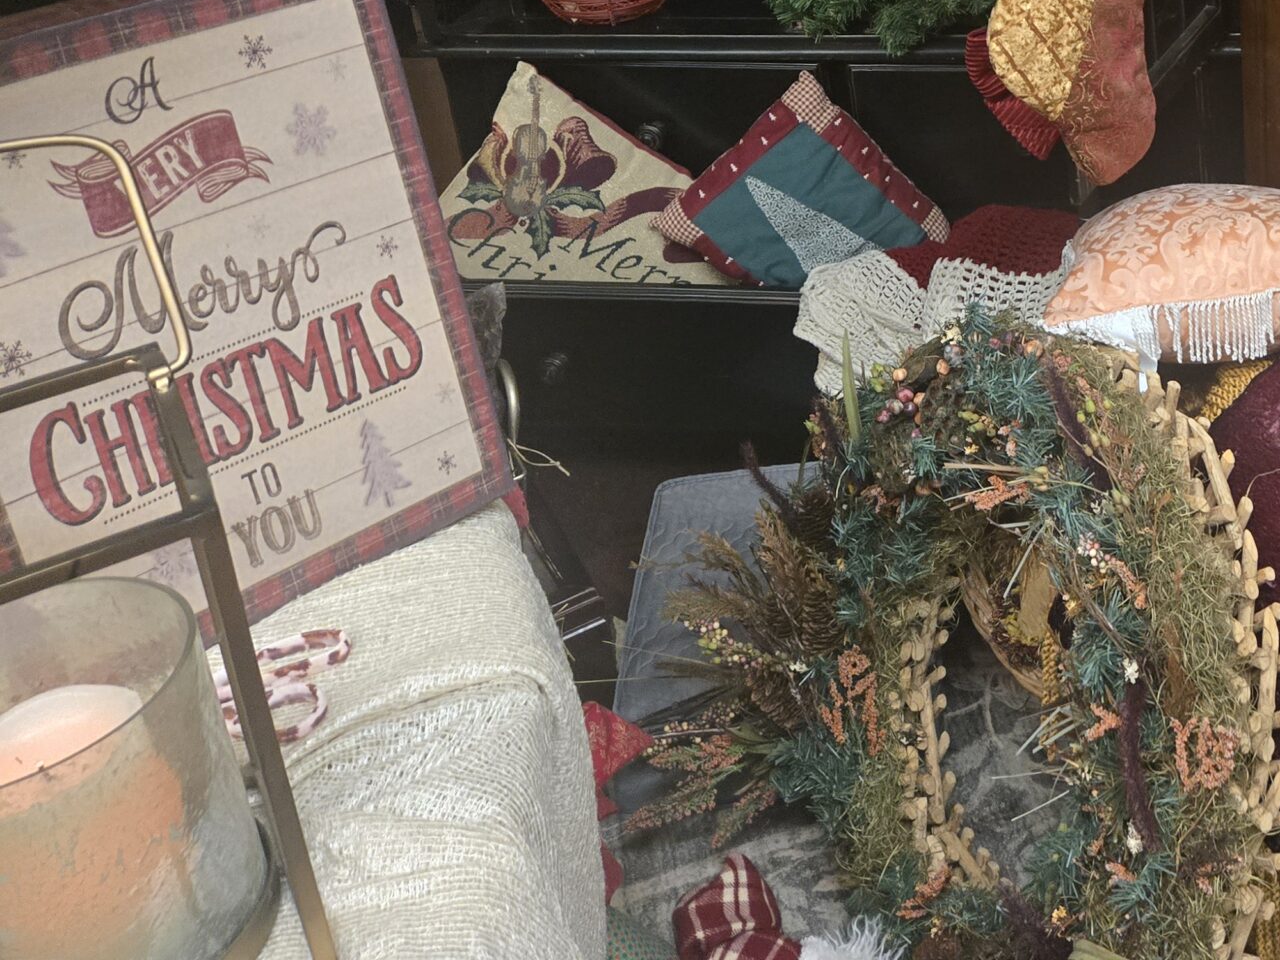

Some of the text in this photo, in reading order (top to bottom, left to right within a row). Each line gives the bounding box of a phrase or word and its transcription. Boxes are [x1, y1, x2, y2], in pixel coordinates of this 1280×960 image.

[105, 56, 174, 124] A
[114, 128, 205, 200] ERY
[58, 221, 346, 360] Merry
[241, 461, 283, 506] TO
[230, 488, 323, 568] YOU
